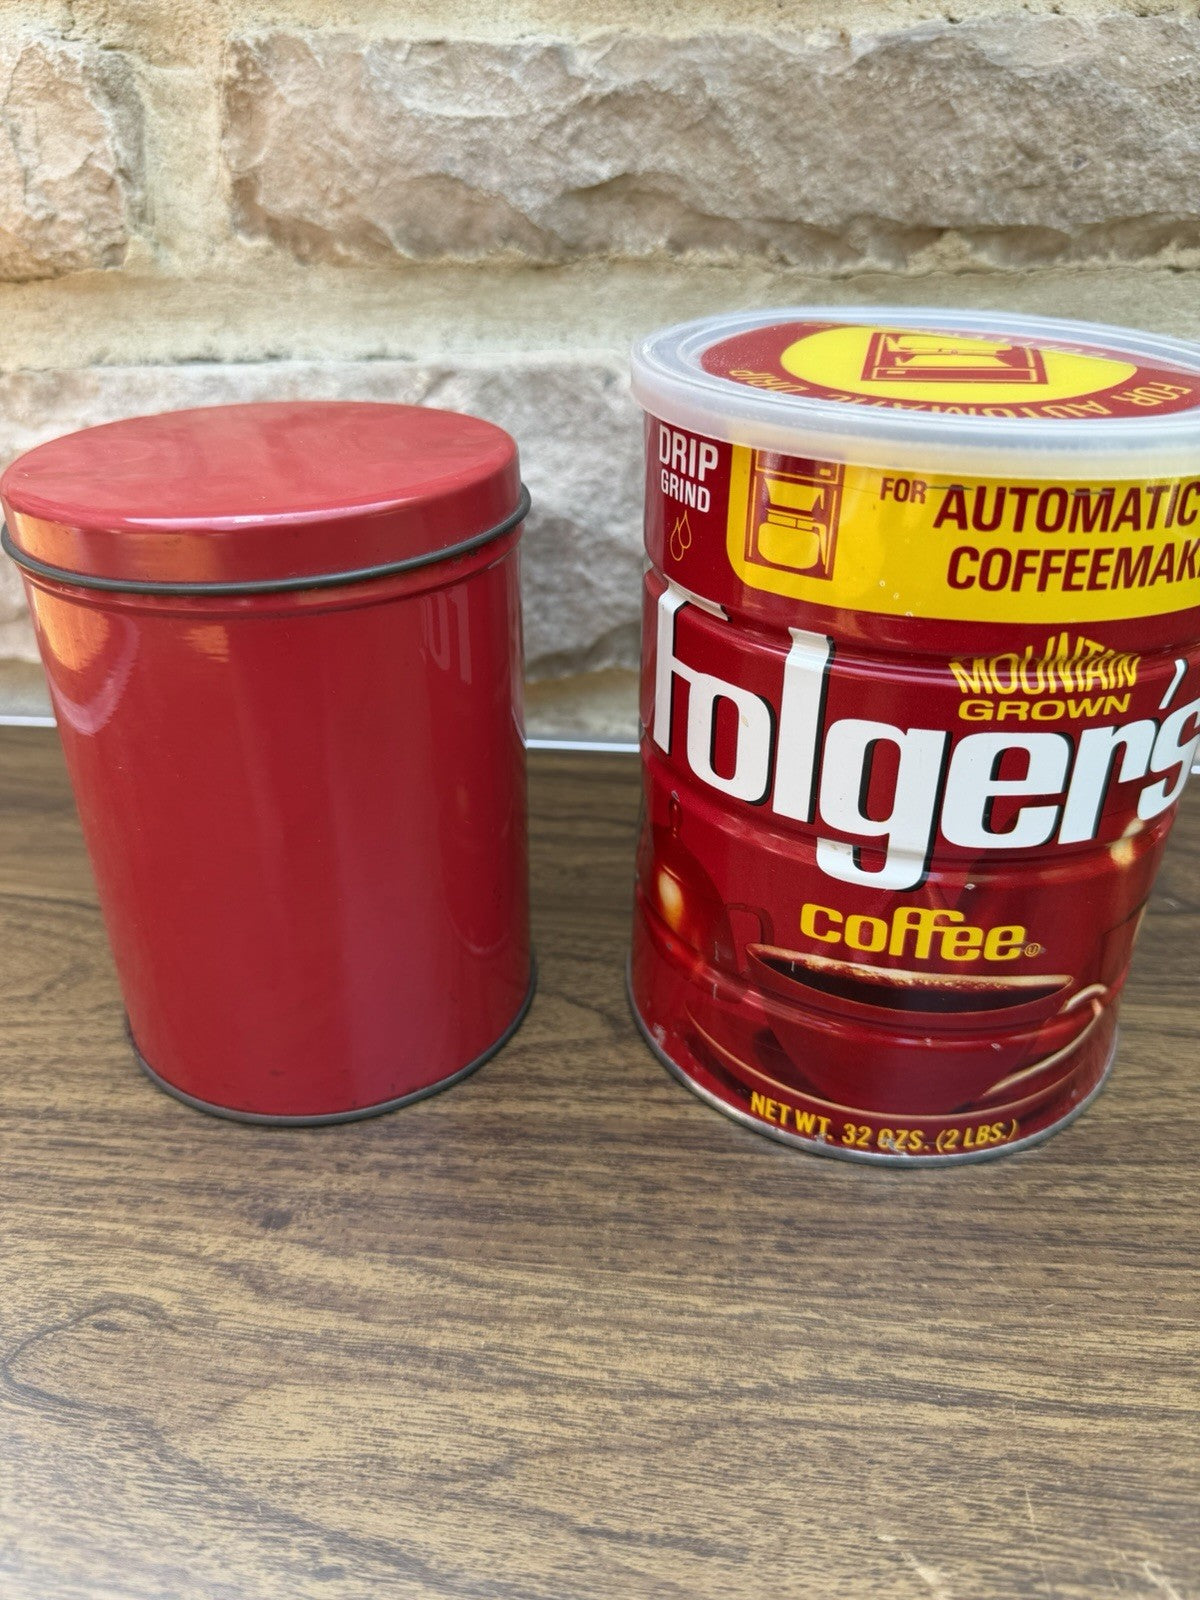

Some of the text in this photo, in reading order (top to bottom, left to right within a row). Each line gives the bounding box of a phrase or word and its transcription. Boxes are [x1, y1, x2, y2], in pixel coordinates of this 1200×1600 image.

[729, 368, 810, 394] DRIP
[1110, 380, 1193, 407] FOR
[659, 424, 719, 482] DRIP
[661, 468, 711, 514] GRIND
[880, 477, 1200, 533] FOR AUTOMATIC
[946, 538, 1200, 592] COFFEEMAK
[948, 631, 1141, 695] MOUNTAIN
[958, 693, 1132, 721] GROWN
[800, 903, 1026, 961] coffee
[751, 1091, 790, 1125] NET
[795, 1109, 834, 1140] WT.
[841, 1123, 873, 1146] 32
[963, 1119, 1018, 1149] LBS.)
